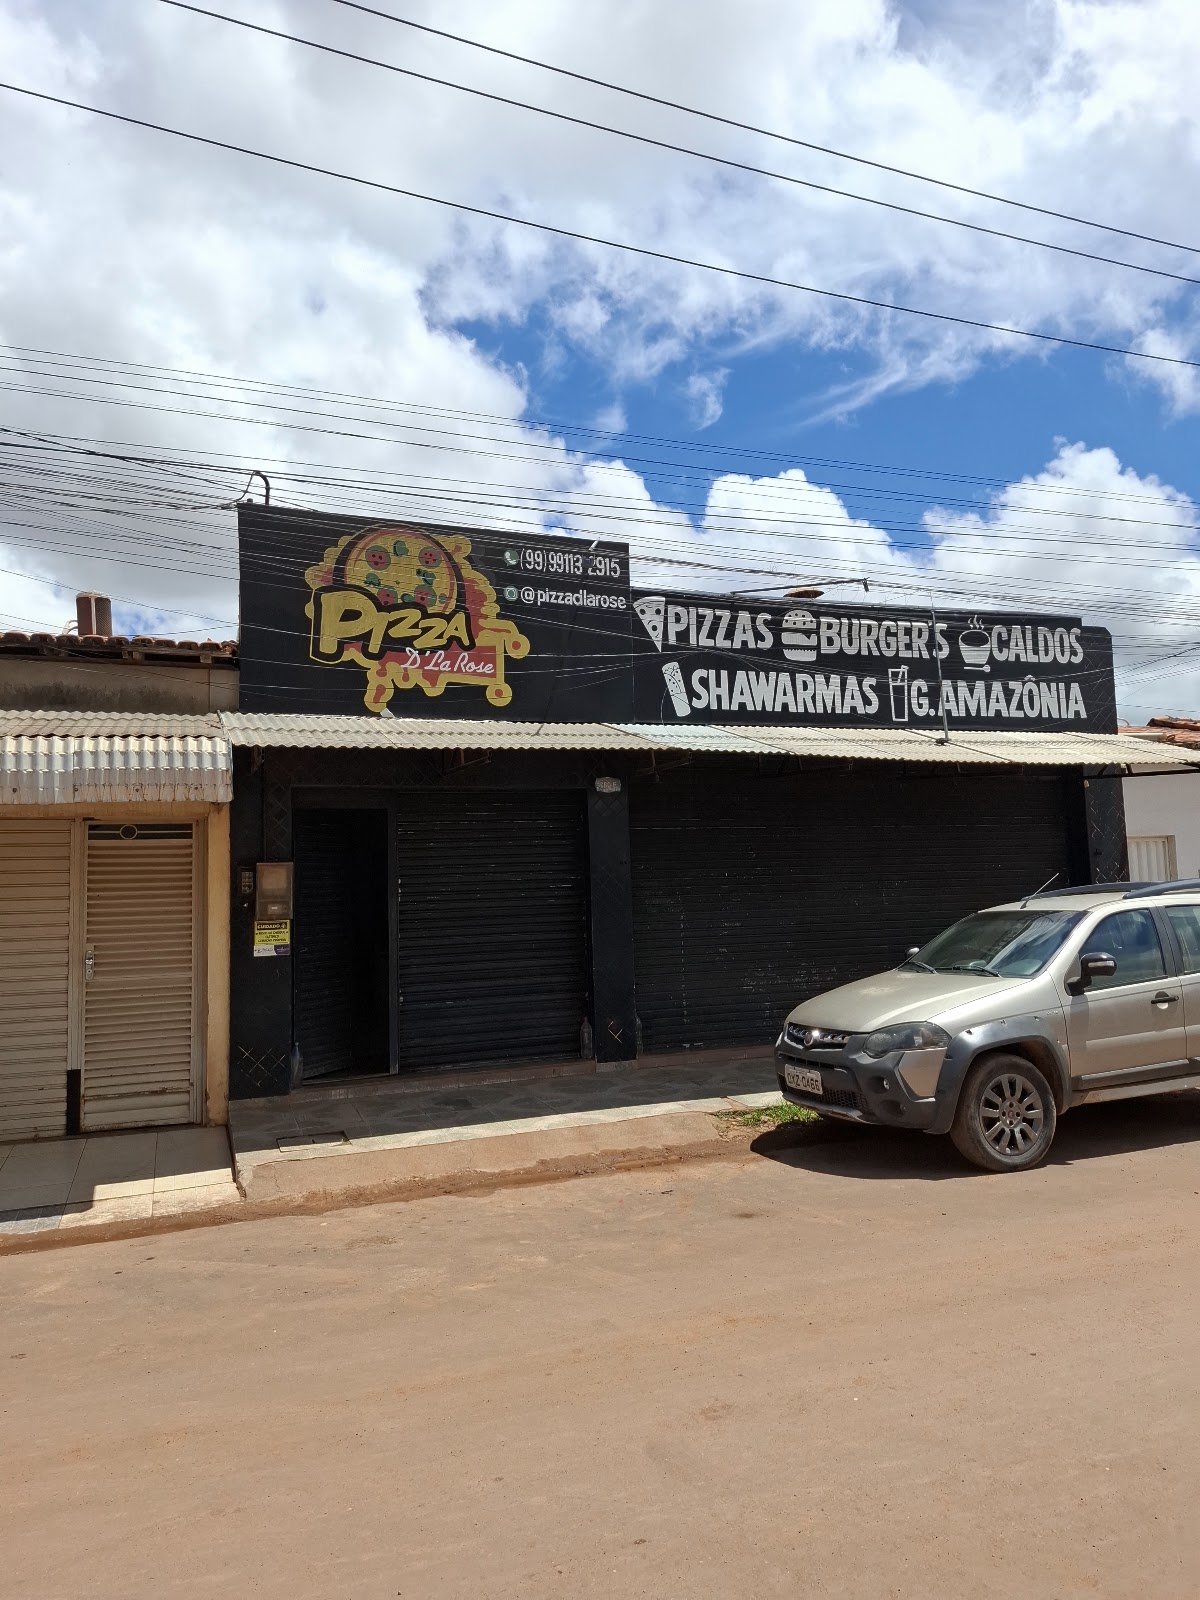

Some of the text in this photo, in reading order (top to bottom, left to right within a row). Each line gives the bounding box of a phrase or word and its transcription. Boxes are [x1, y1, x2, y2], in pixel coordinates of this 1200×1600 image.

[588, 556, 621, 577] 2915
[520, 586, 627, 609] @pizzadlarose
[667, 605, 774, 650] PIZZAS
[991, 624, 1084, 664] CALDOS
[453, 651, 495, 674] Rose
[691, 668, 880, 714] SHAWARMAS
